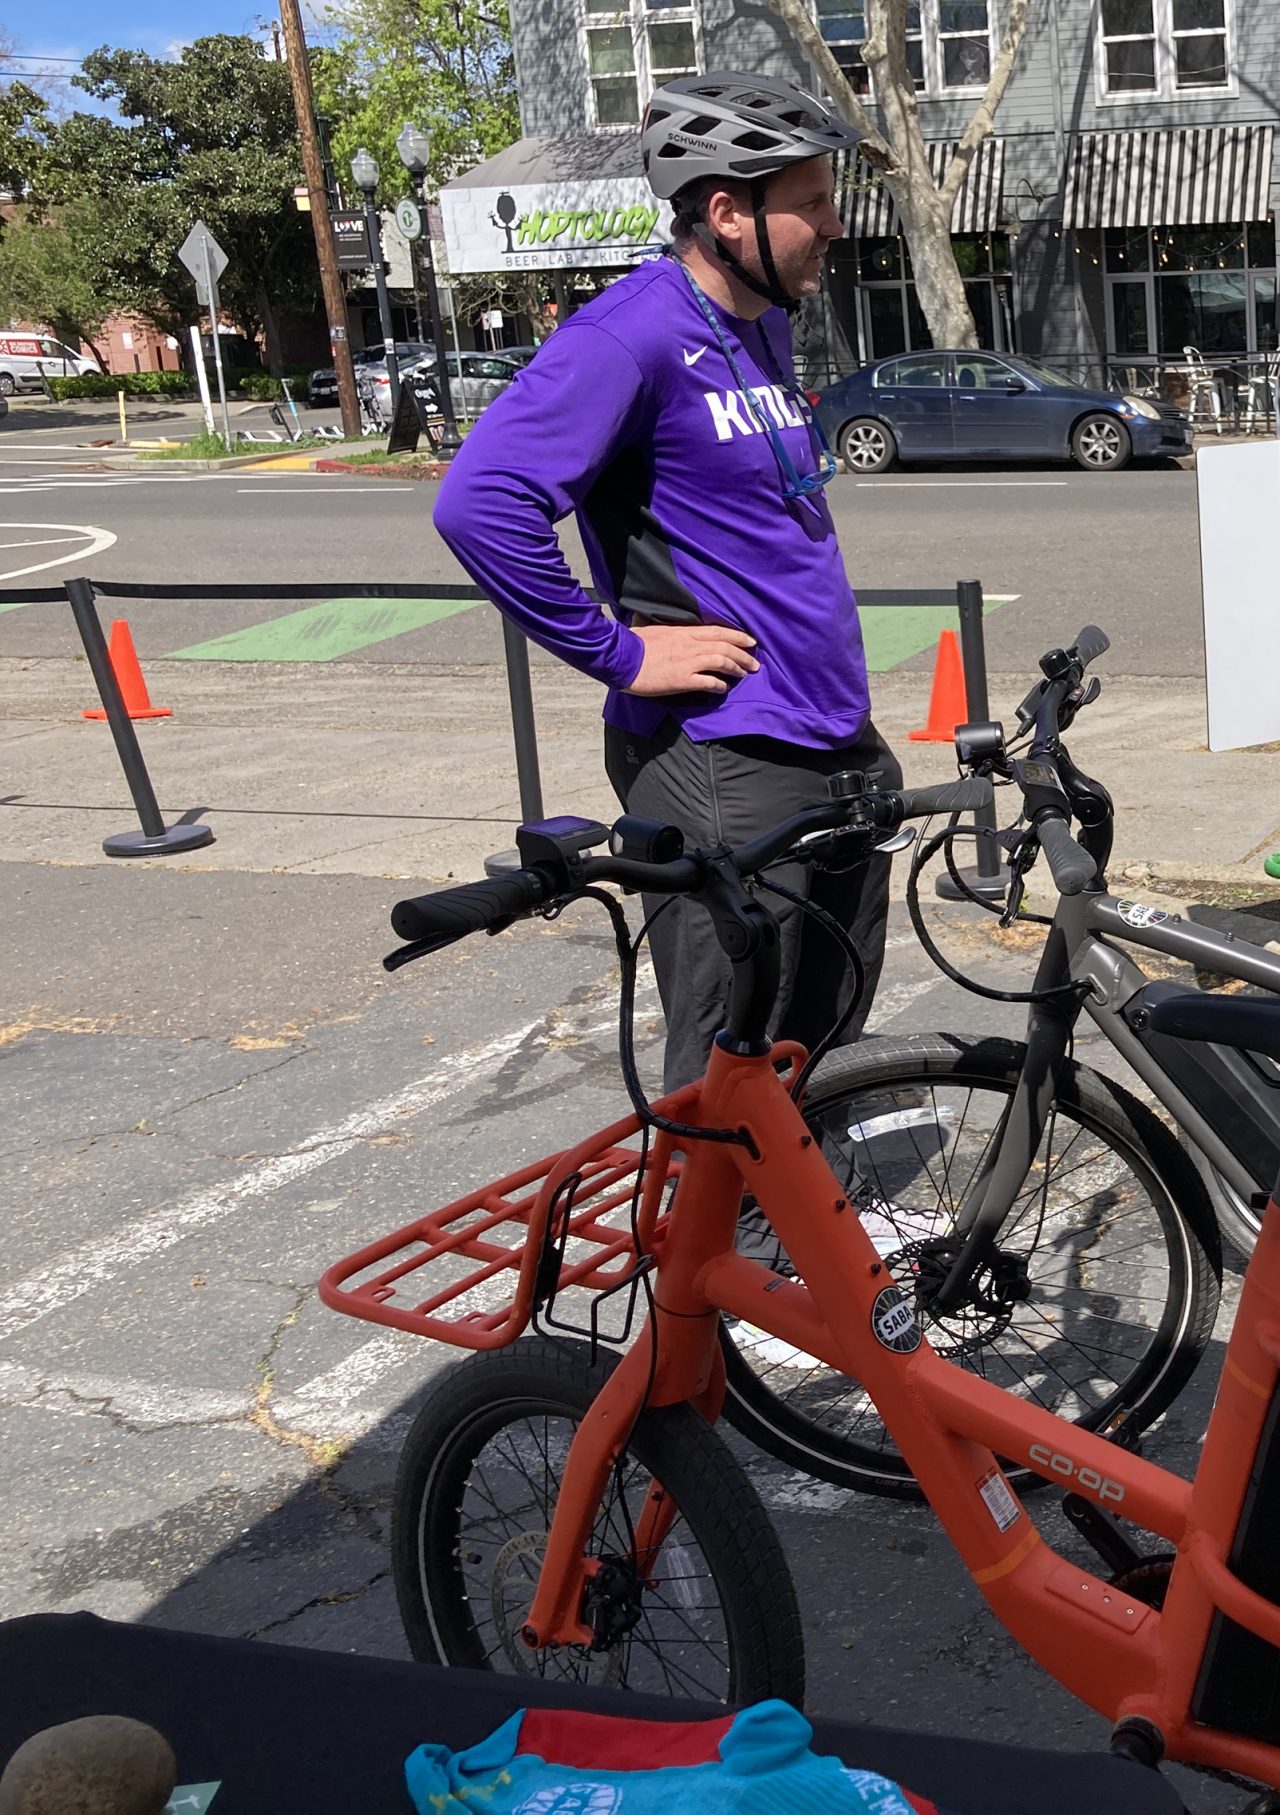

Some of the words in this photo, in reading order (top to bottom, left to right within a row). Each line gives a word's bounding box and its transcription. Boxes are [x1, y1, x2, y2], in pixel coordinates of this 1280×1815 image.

[667, 132, 717, 151] SCHWINN
[517, 205, 660, 245] HOPTOLOGY
[505, 256, 538, 267] BEER
[549, 253, 573, 265] LAB
[600, 250, 658, 265] KITC
[883, 1305, 912, 1336] SABA
